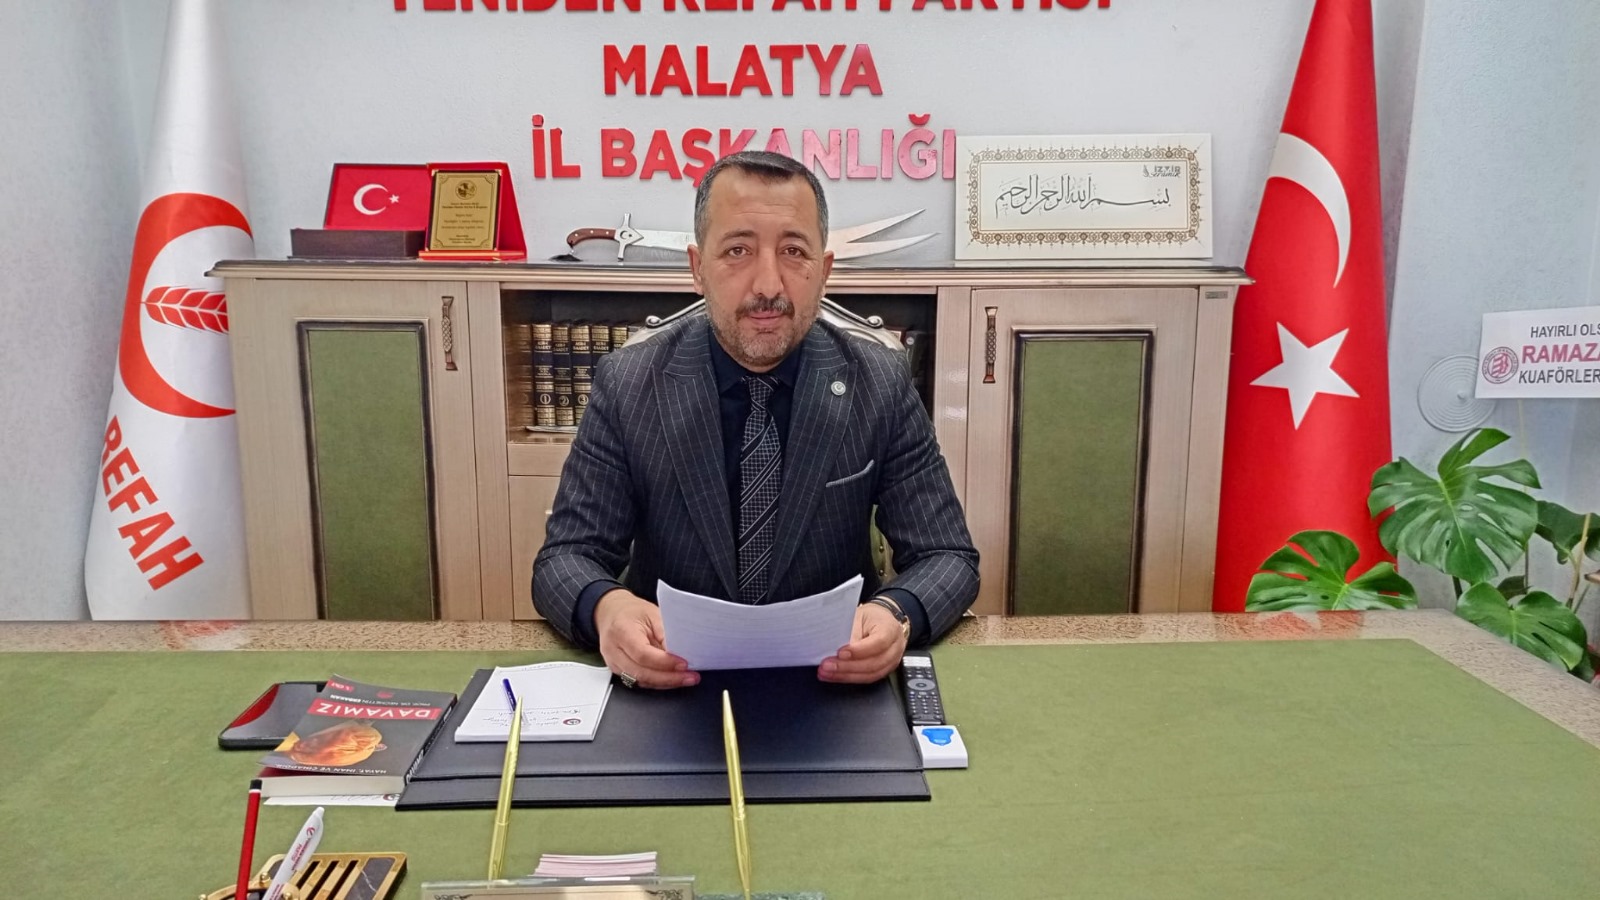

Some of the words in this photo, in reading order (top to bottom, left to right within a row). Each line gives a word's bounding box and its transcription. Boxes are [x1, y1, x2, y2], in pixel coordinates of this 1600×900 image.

[603, 43, 883, 97] MALATYA
[532, 114, 581, 179] İL
[1530, 324, 1577, 338] HAYIRLI
[1522, 343, 1600, 364] RAMAZ
[101, 415, 204, 591] REFAH
[317, 702, 431, 718] DAVAMIZ
